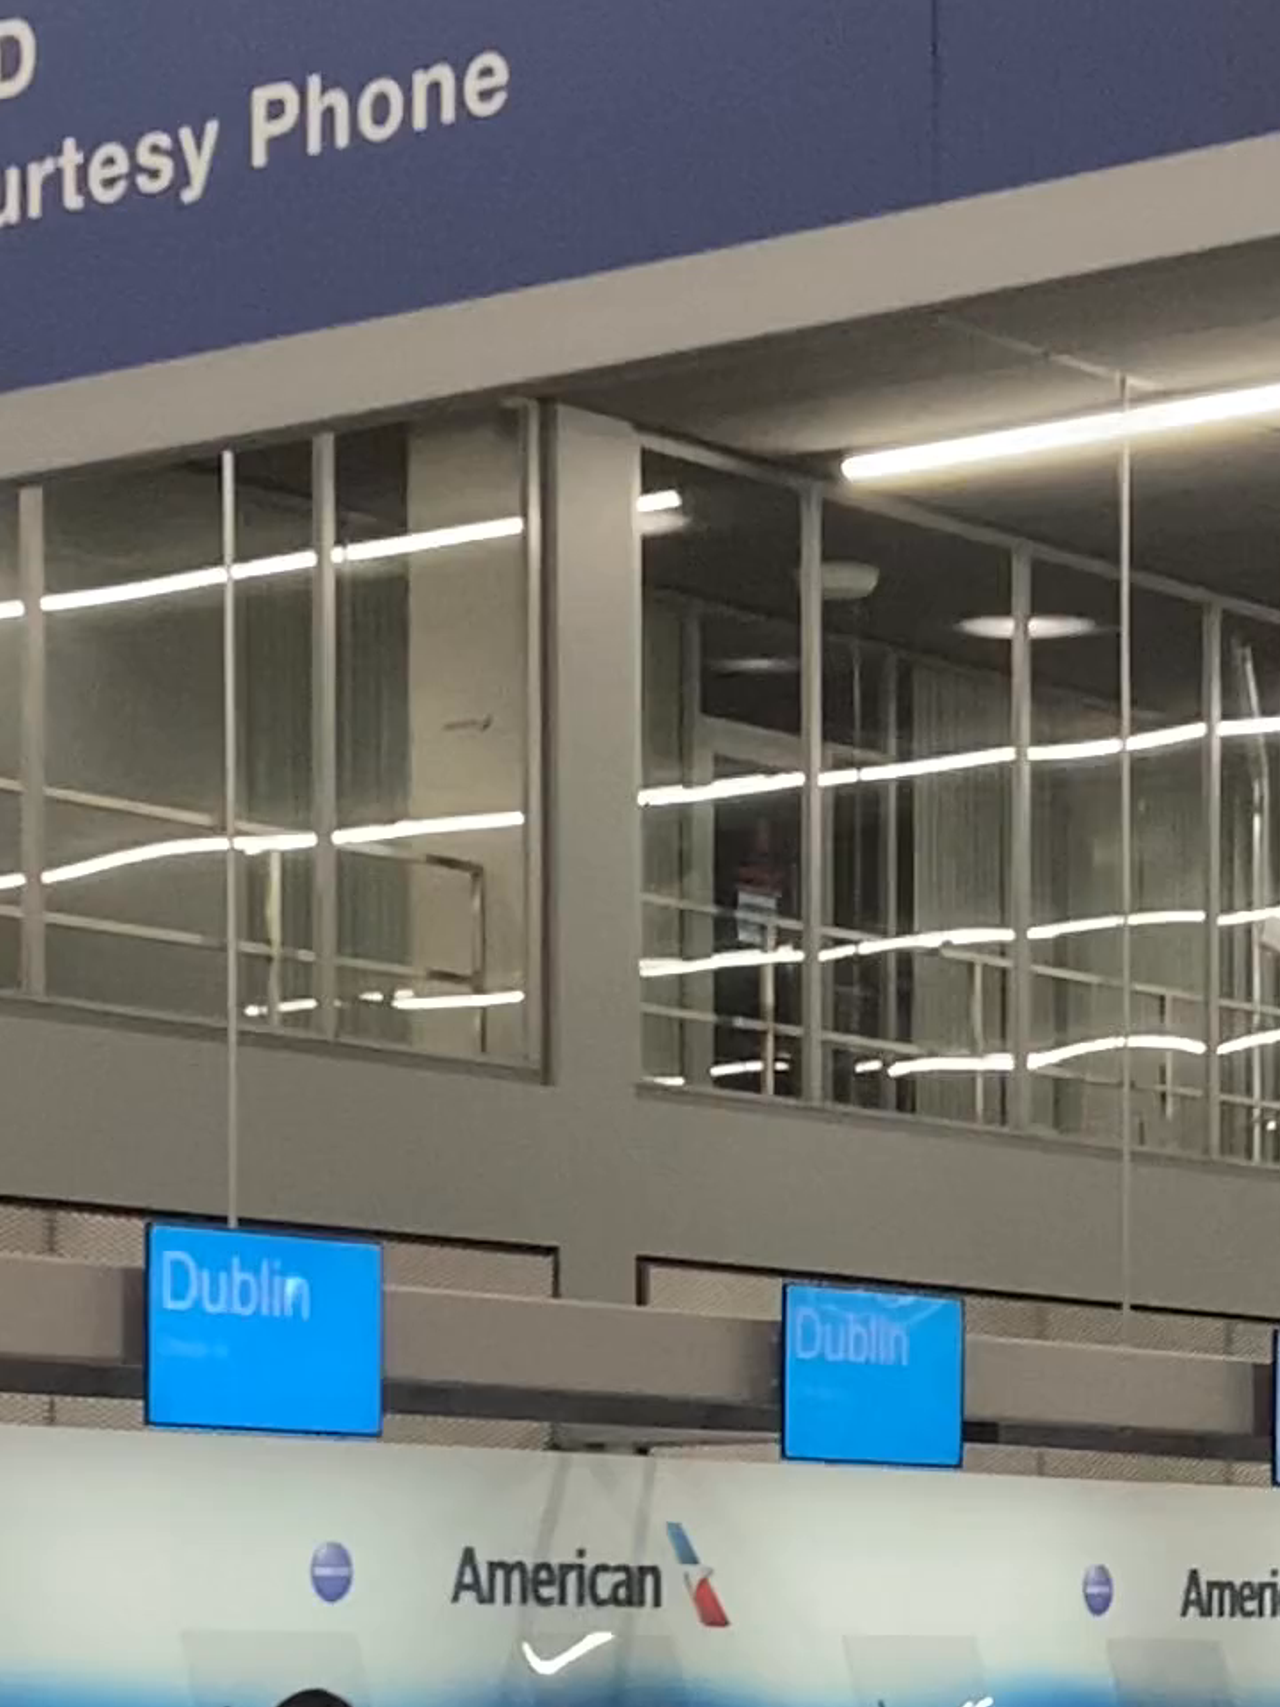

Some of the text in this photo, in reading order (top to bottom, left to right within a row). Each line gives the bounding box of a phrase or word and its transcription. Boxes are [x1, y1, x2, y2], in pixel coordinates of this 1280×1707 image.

[251, 50, 510, 168] Phone
[162, 1250, 311, 1320] Dublin
[795, 1304, 910, 1366] Dublin
[451, 1547, 662, 1608] American
